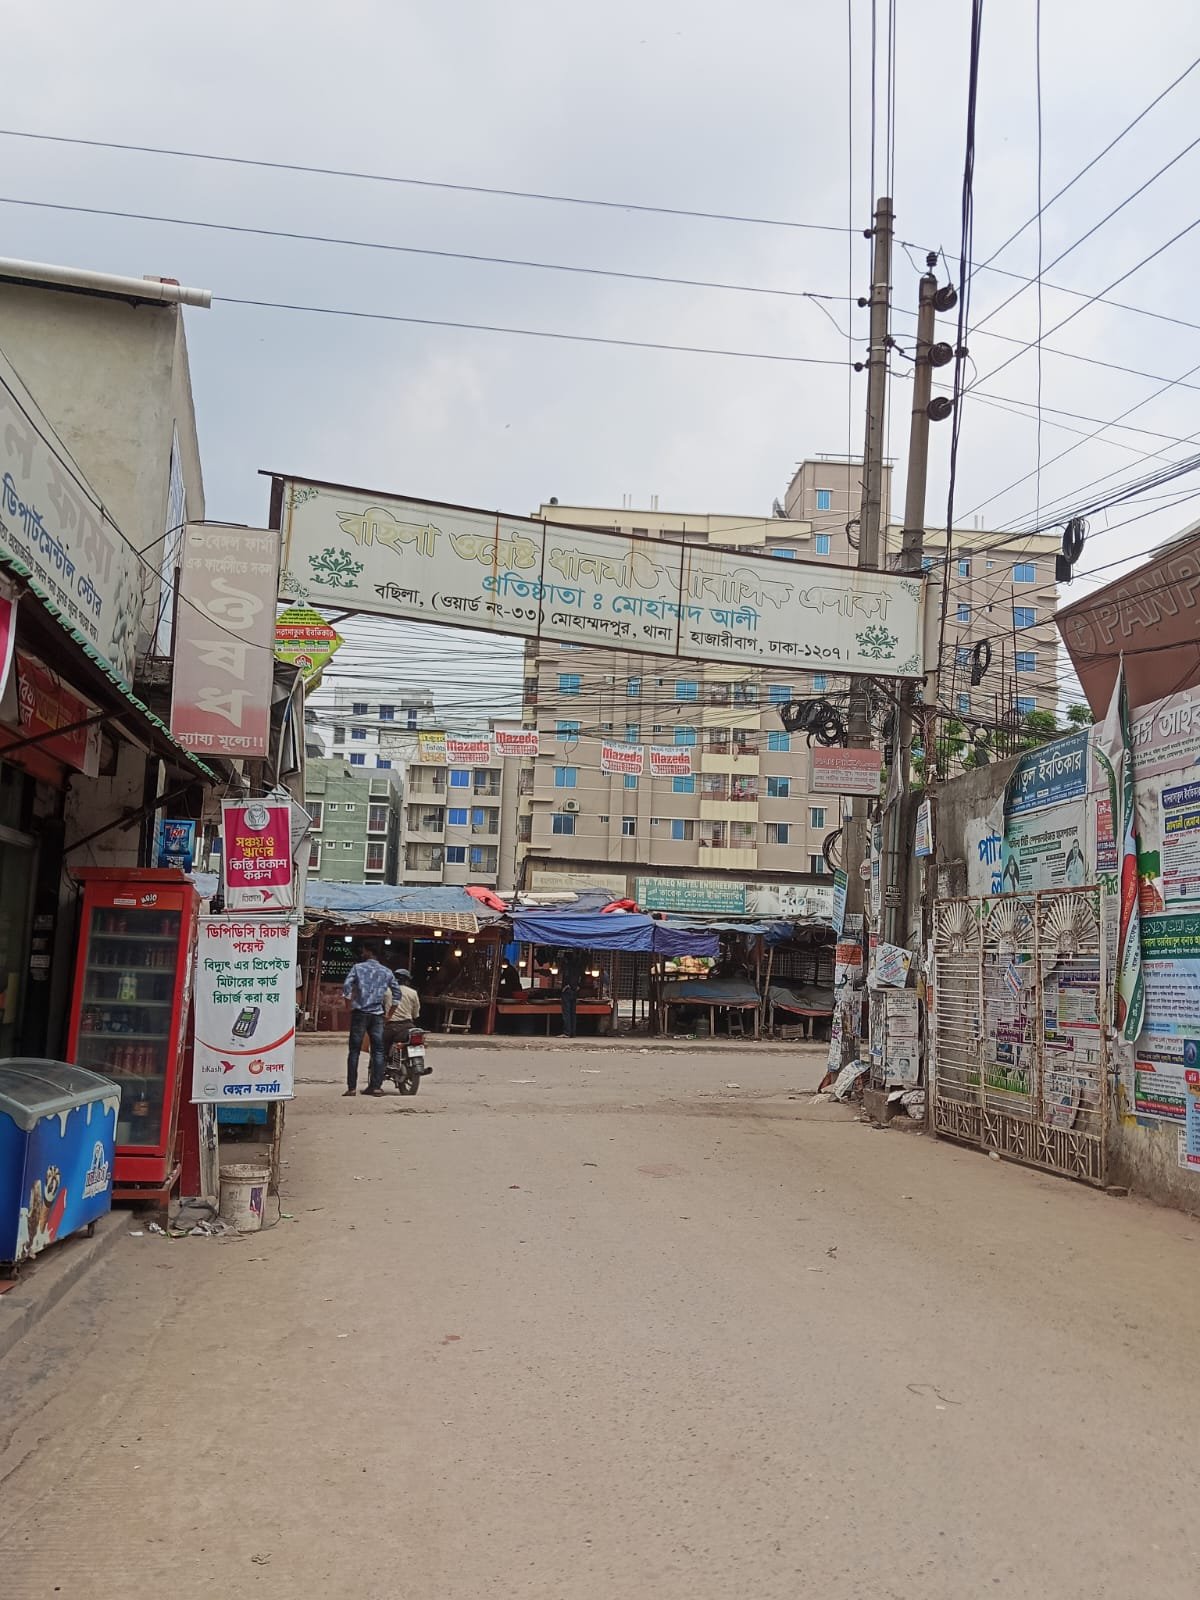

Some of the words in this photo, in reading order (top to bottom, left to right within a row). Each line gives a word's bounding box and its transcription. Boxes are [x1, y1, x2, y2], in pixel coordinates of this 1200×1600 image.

[482, 572, 585, 608] প্রতিষ্ঠাতা
[612, 596, 704, 624] মোহাম্মদ
[709, 605, 761, 631] আলী
[799, 587, 892, 620] এলাকা
[643, 625, 673, 641] থানা
[496, 731, 538, 744] Mazeda
[602, 747, 643, 763] Mazeda
[651, 752, 690, 764] Mazeda
[1037, 750, 1083, 782] ইবতিকার
[235, 836, 264, 847] সঞ্চয়
[266, 837, 275, 846] ও
[242, 846, 275, 857] ঋণের
[229, 857, 254, 870] কিস্তি
[256, 856, 287, 869] বিকাশ
[243, 869, 272, 881] করুন
[205, 924, 254, 939] ডিপিডিসি
[258, 921, 291, 939] রিচার্জ
[232, 938, 265, 953] পয়েন্ট
[204, 957, 231, 975] বিদ্যুৎ
[234, 960, 249, 971] এর
[252, 957, 291, 971] প্রিপেইড
[216, 974, 254, 989] মিটারের
[257, 973, 278, 987] কার্ড
[212, 990, 241, 1005] রিচার্জ
[244, 992, 263, 1004] করা
[266, 991, 281, 1004] হয়
[265, 1062, 285, 1073] নগদ
[223, 1083, 252, 1096] বেঙ্গল
[255, 1079, 281, 1093] ফার্মা
